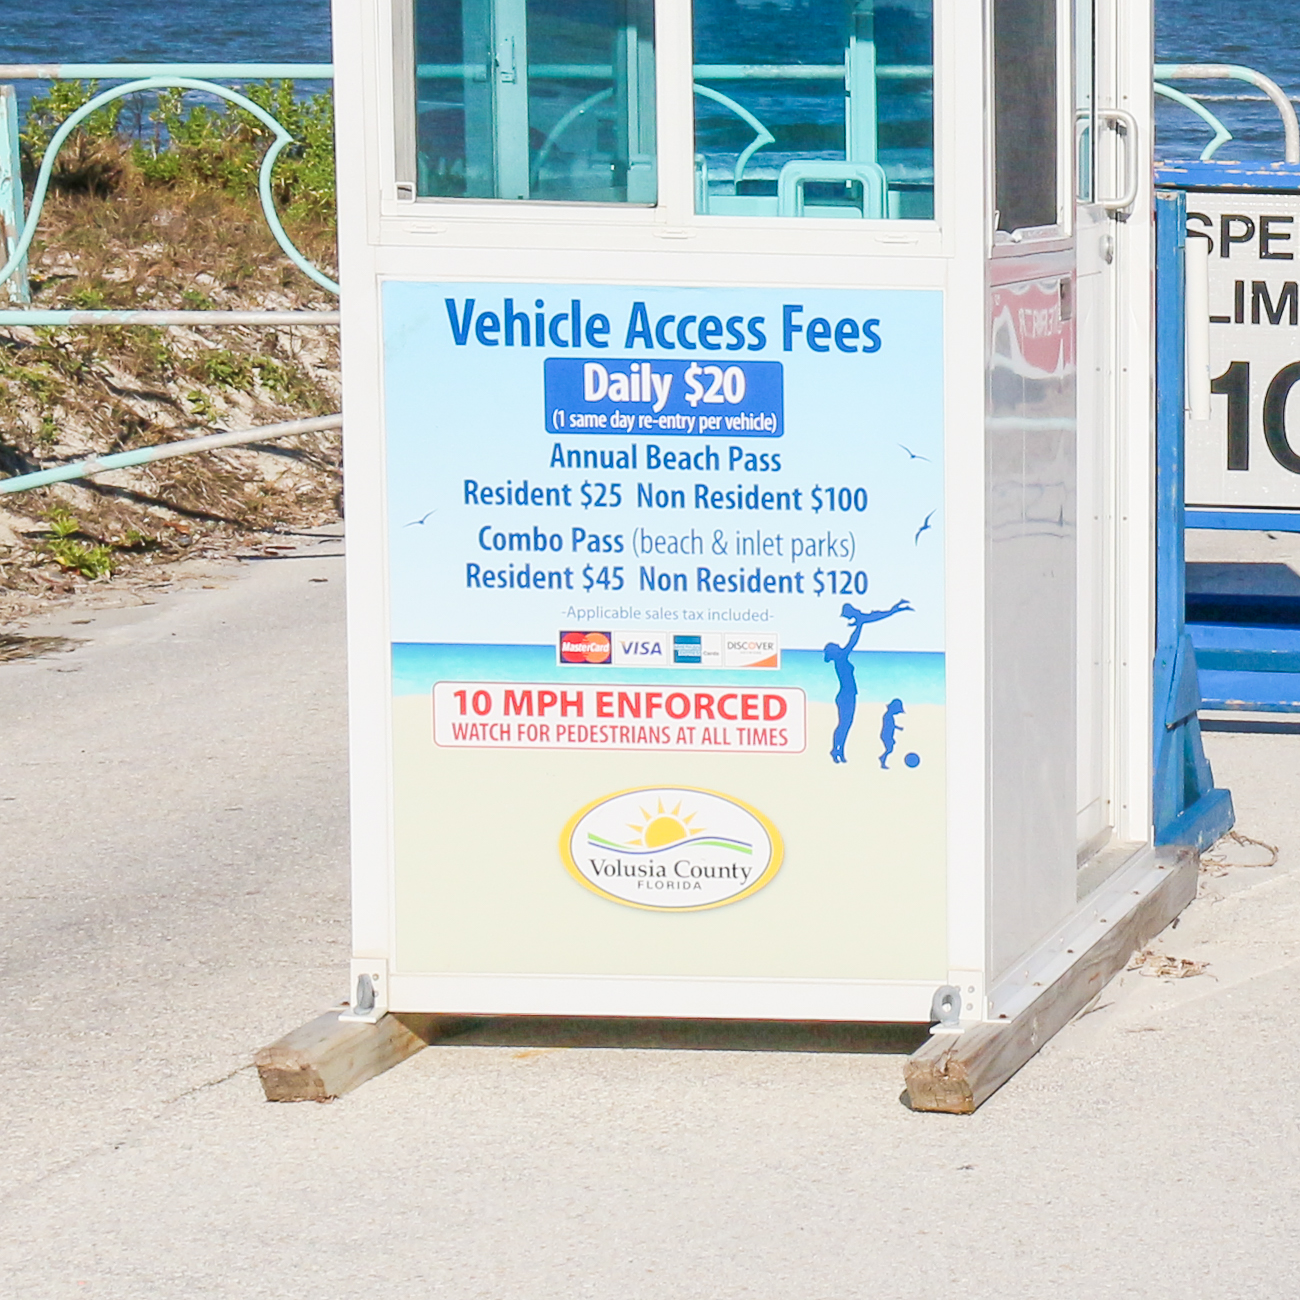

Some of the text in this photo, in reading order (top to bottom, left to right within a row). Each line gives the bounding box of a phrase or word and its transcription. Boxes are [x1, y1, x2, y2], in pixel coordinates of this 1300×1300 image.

[445, 298, 881, 353] Vehicle Access Fees
[584, 363, 745, 413] Daily $20
[553, 409, 776, 433] (1 same day re-entry per vehicle)
[550, 443, 781, 472] Annual Beach Pass
[464, 480, 867, 514] Resident $25 Non Resident $100
[479, 526, 855, 563] Combo Pass (beach & inlet parks)
[467, 563, 868, 597] Resident $45 Non Resident $120
[562, 606, 774, 621] -Applicable sales tax included-
[562, 642, 610, 653] MasterCard
[620, 641, 662, 655] VISA
[728, 642, 774, 650] DISCOVER
[454, 690, 787, 721] 10 MPH ENFORCED
[452, 723, 788, 746] WATCH FOR PEDESTRIANS AT ALL TIMES
[590, 859, 751, 885] Volusia County
[638, 880, 701, 890] FLORIDA
